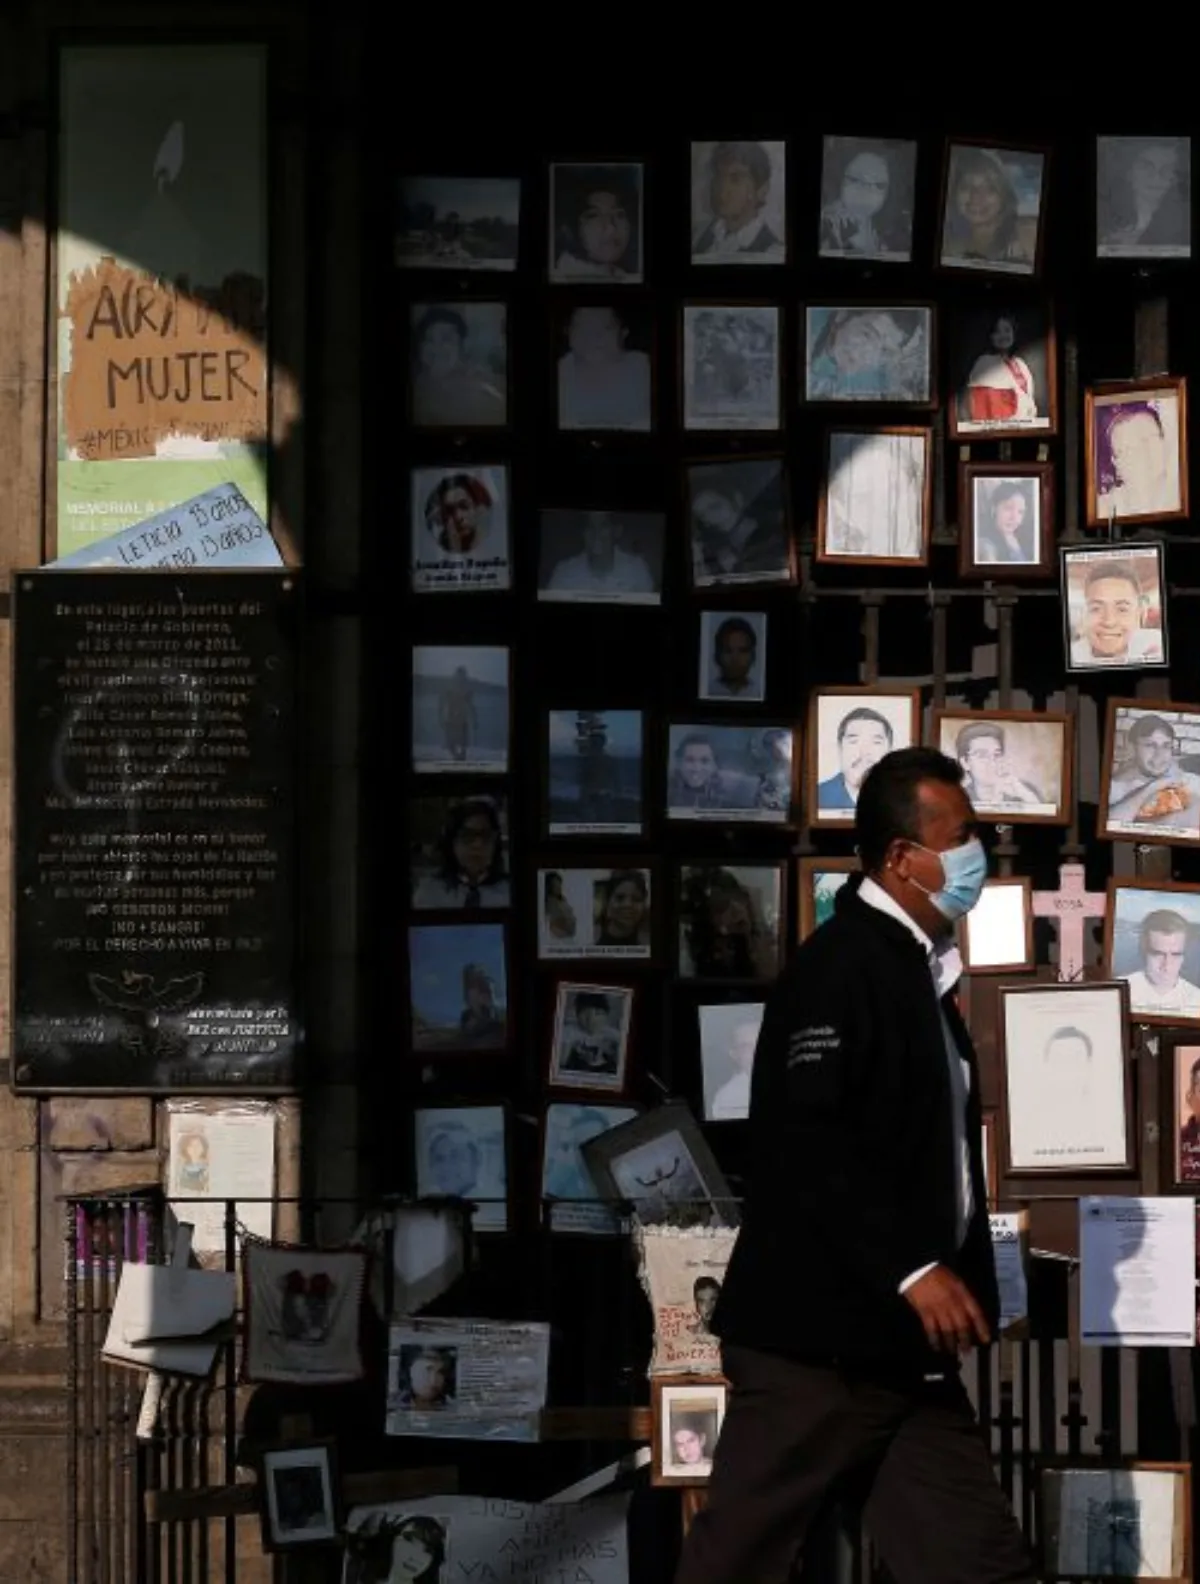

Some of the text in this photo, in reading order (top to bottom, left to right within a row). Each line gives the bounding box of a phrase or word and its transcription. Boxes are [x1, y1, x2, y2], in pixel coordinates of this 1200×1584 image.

[107, 349, 258, 409] MUJER
[66, 500, 139, 516] MEMORIAL
[105, 938, 164, 951] DERECHO
